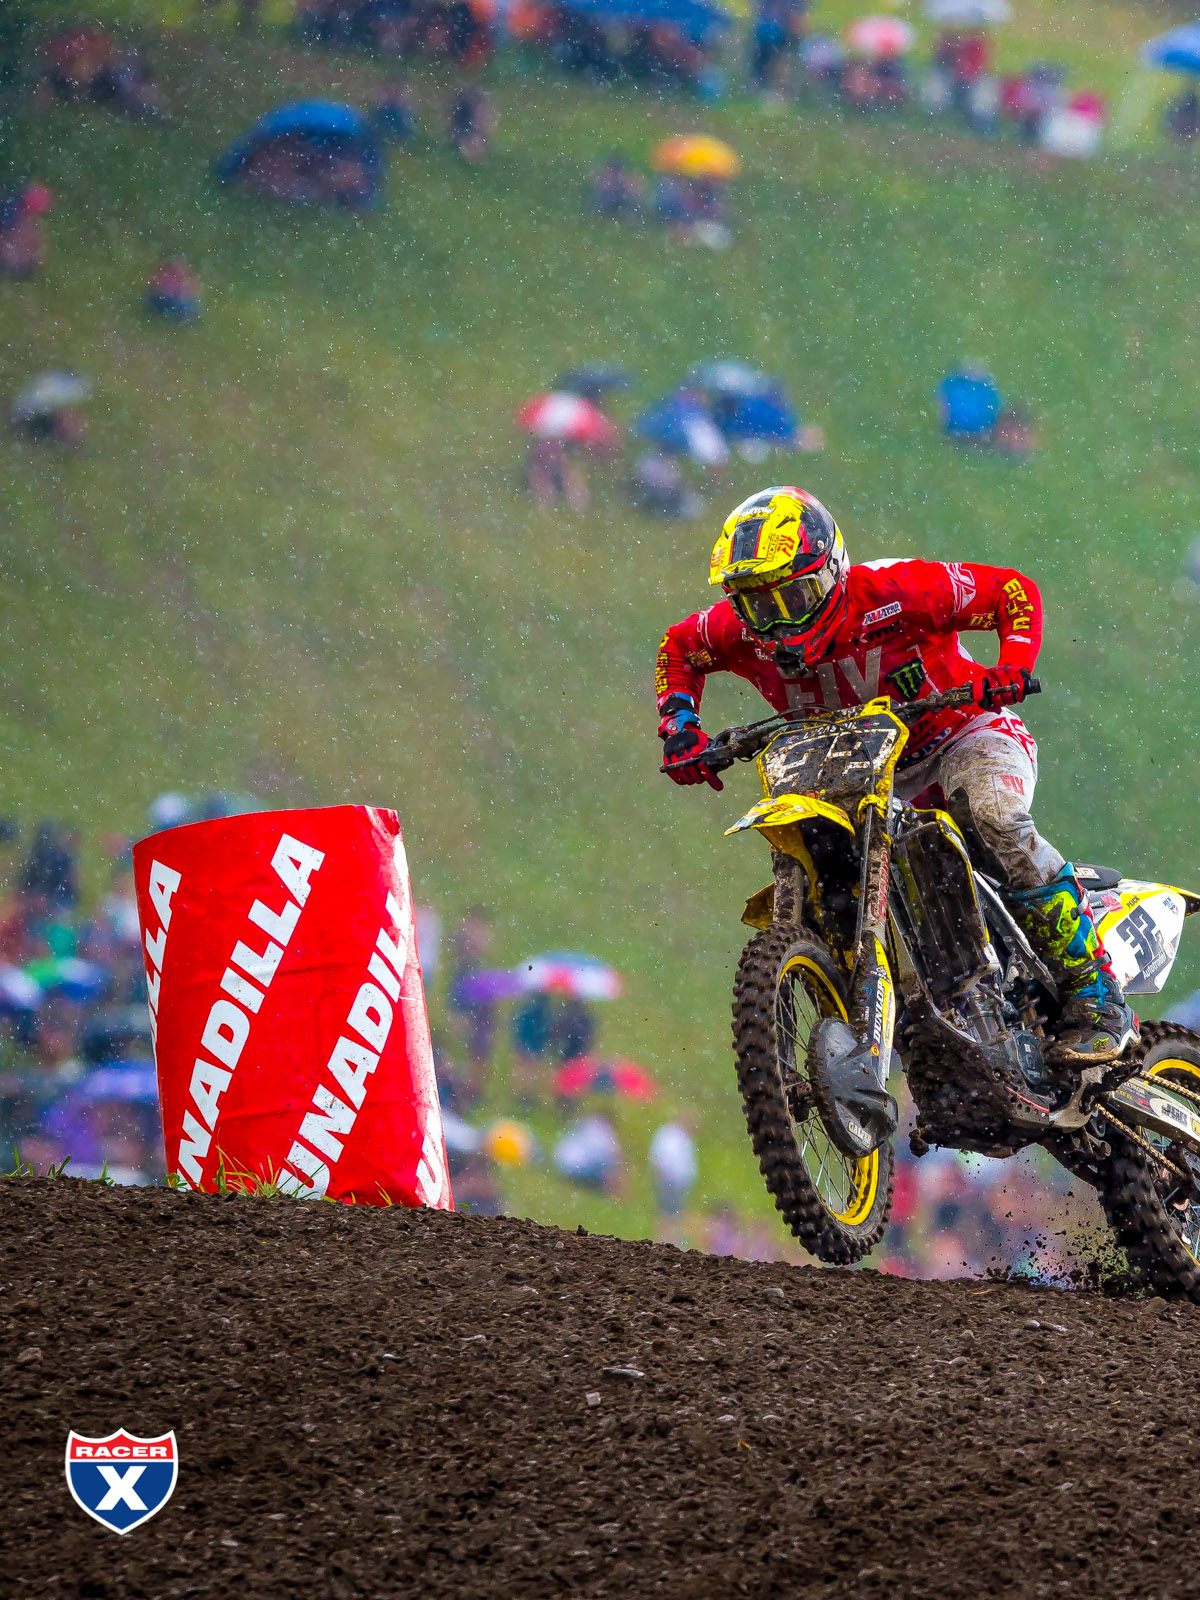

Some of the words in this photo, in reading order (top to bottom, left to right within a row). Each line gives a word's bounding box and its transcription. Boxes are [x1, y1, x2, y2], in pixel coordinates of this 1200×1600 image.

[803, 724, 837, 740] LUCAS
[1000, 775, 1025, 796] FLY
[1074, 867, 1100, 879] JGR
[1126, 896, 1141, 909] PEICK
[1116, 905, 1165, 972] 32
[873, 979, 886, 1044] DUNLOP
